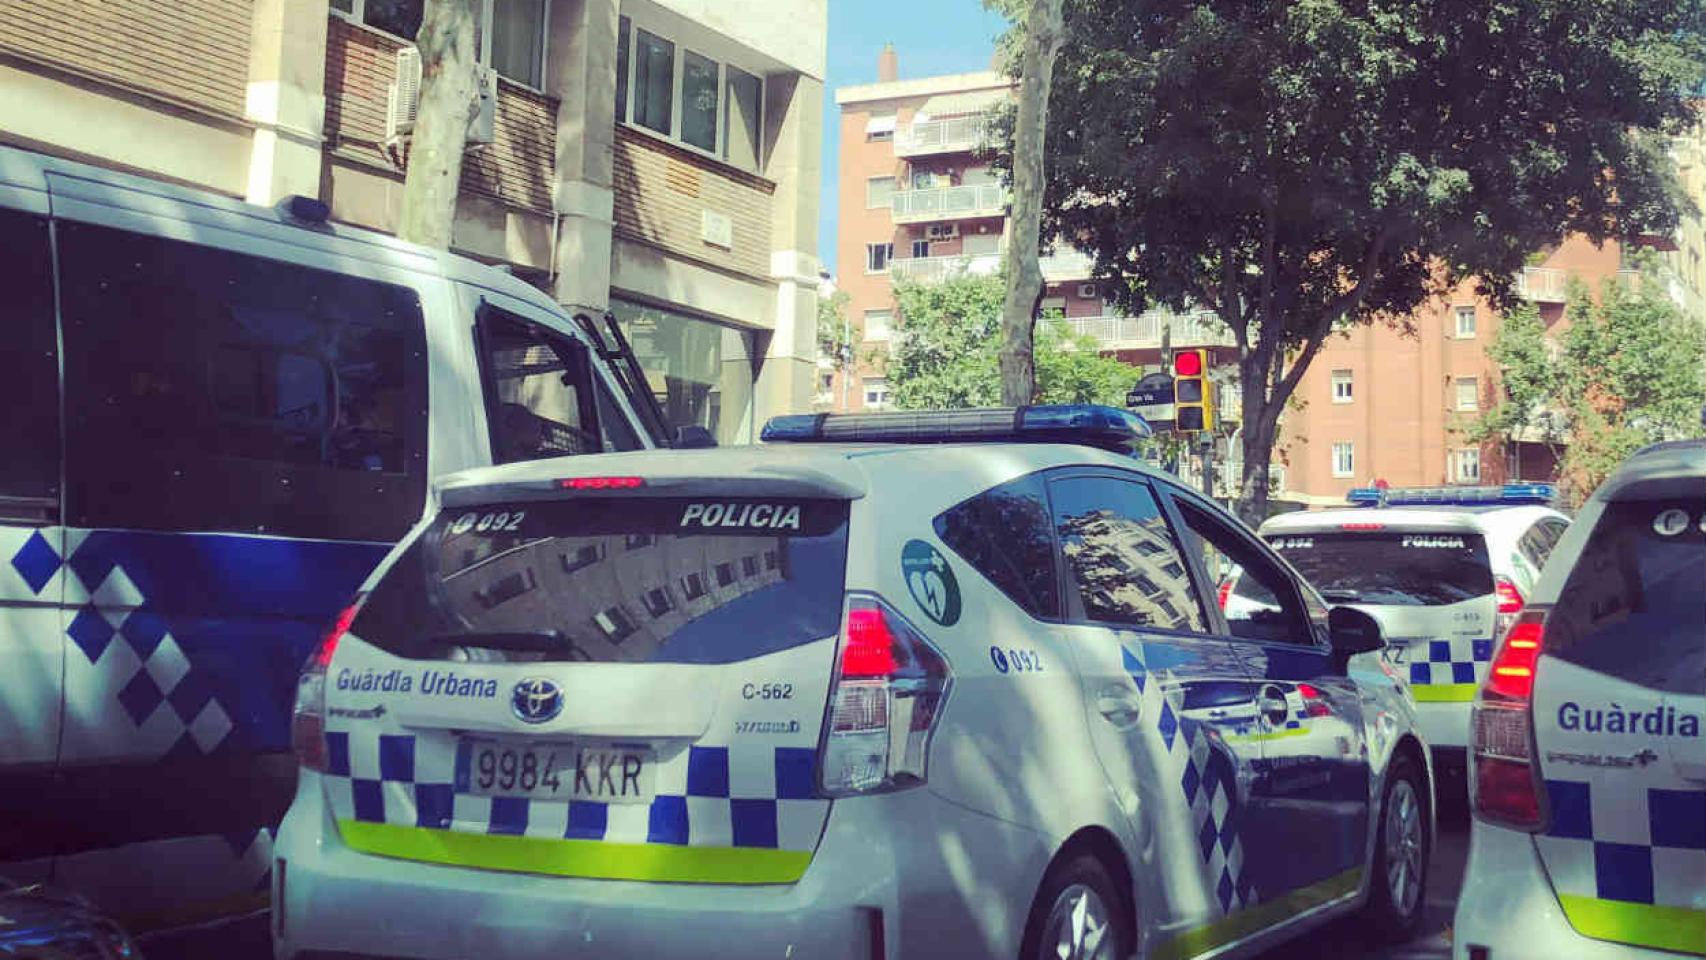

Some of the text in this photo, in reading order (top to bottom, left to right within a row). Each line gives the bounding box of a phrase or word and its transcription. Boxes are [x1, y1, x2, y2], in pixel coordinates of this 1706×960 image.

[476, 511, 525, 531] 092
[680, 503, 801, 529] POLICIA
[1402, 534, 1464, 548] POLICIA
[1009, 649, 1044, 672] 092
[420, 669, 498, 698] Urbana
[742, 682, 793, 700] C-562
[1557, 701, 1700, 737] Guàrdia
[478, 749, 642, 797] 9984 KKR
